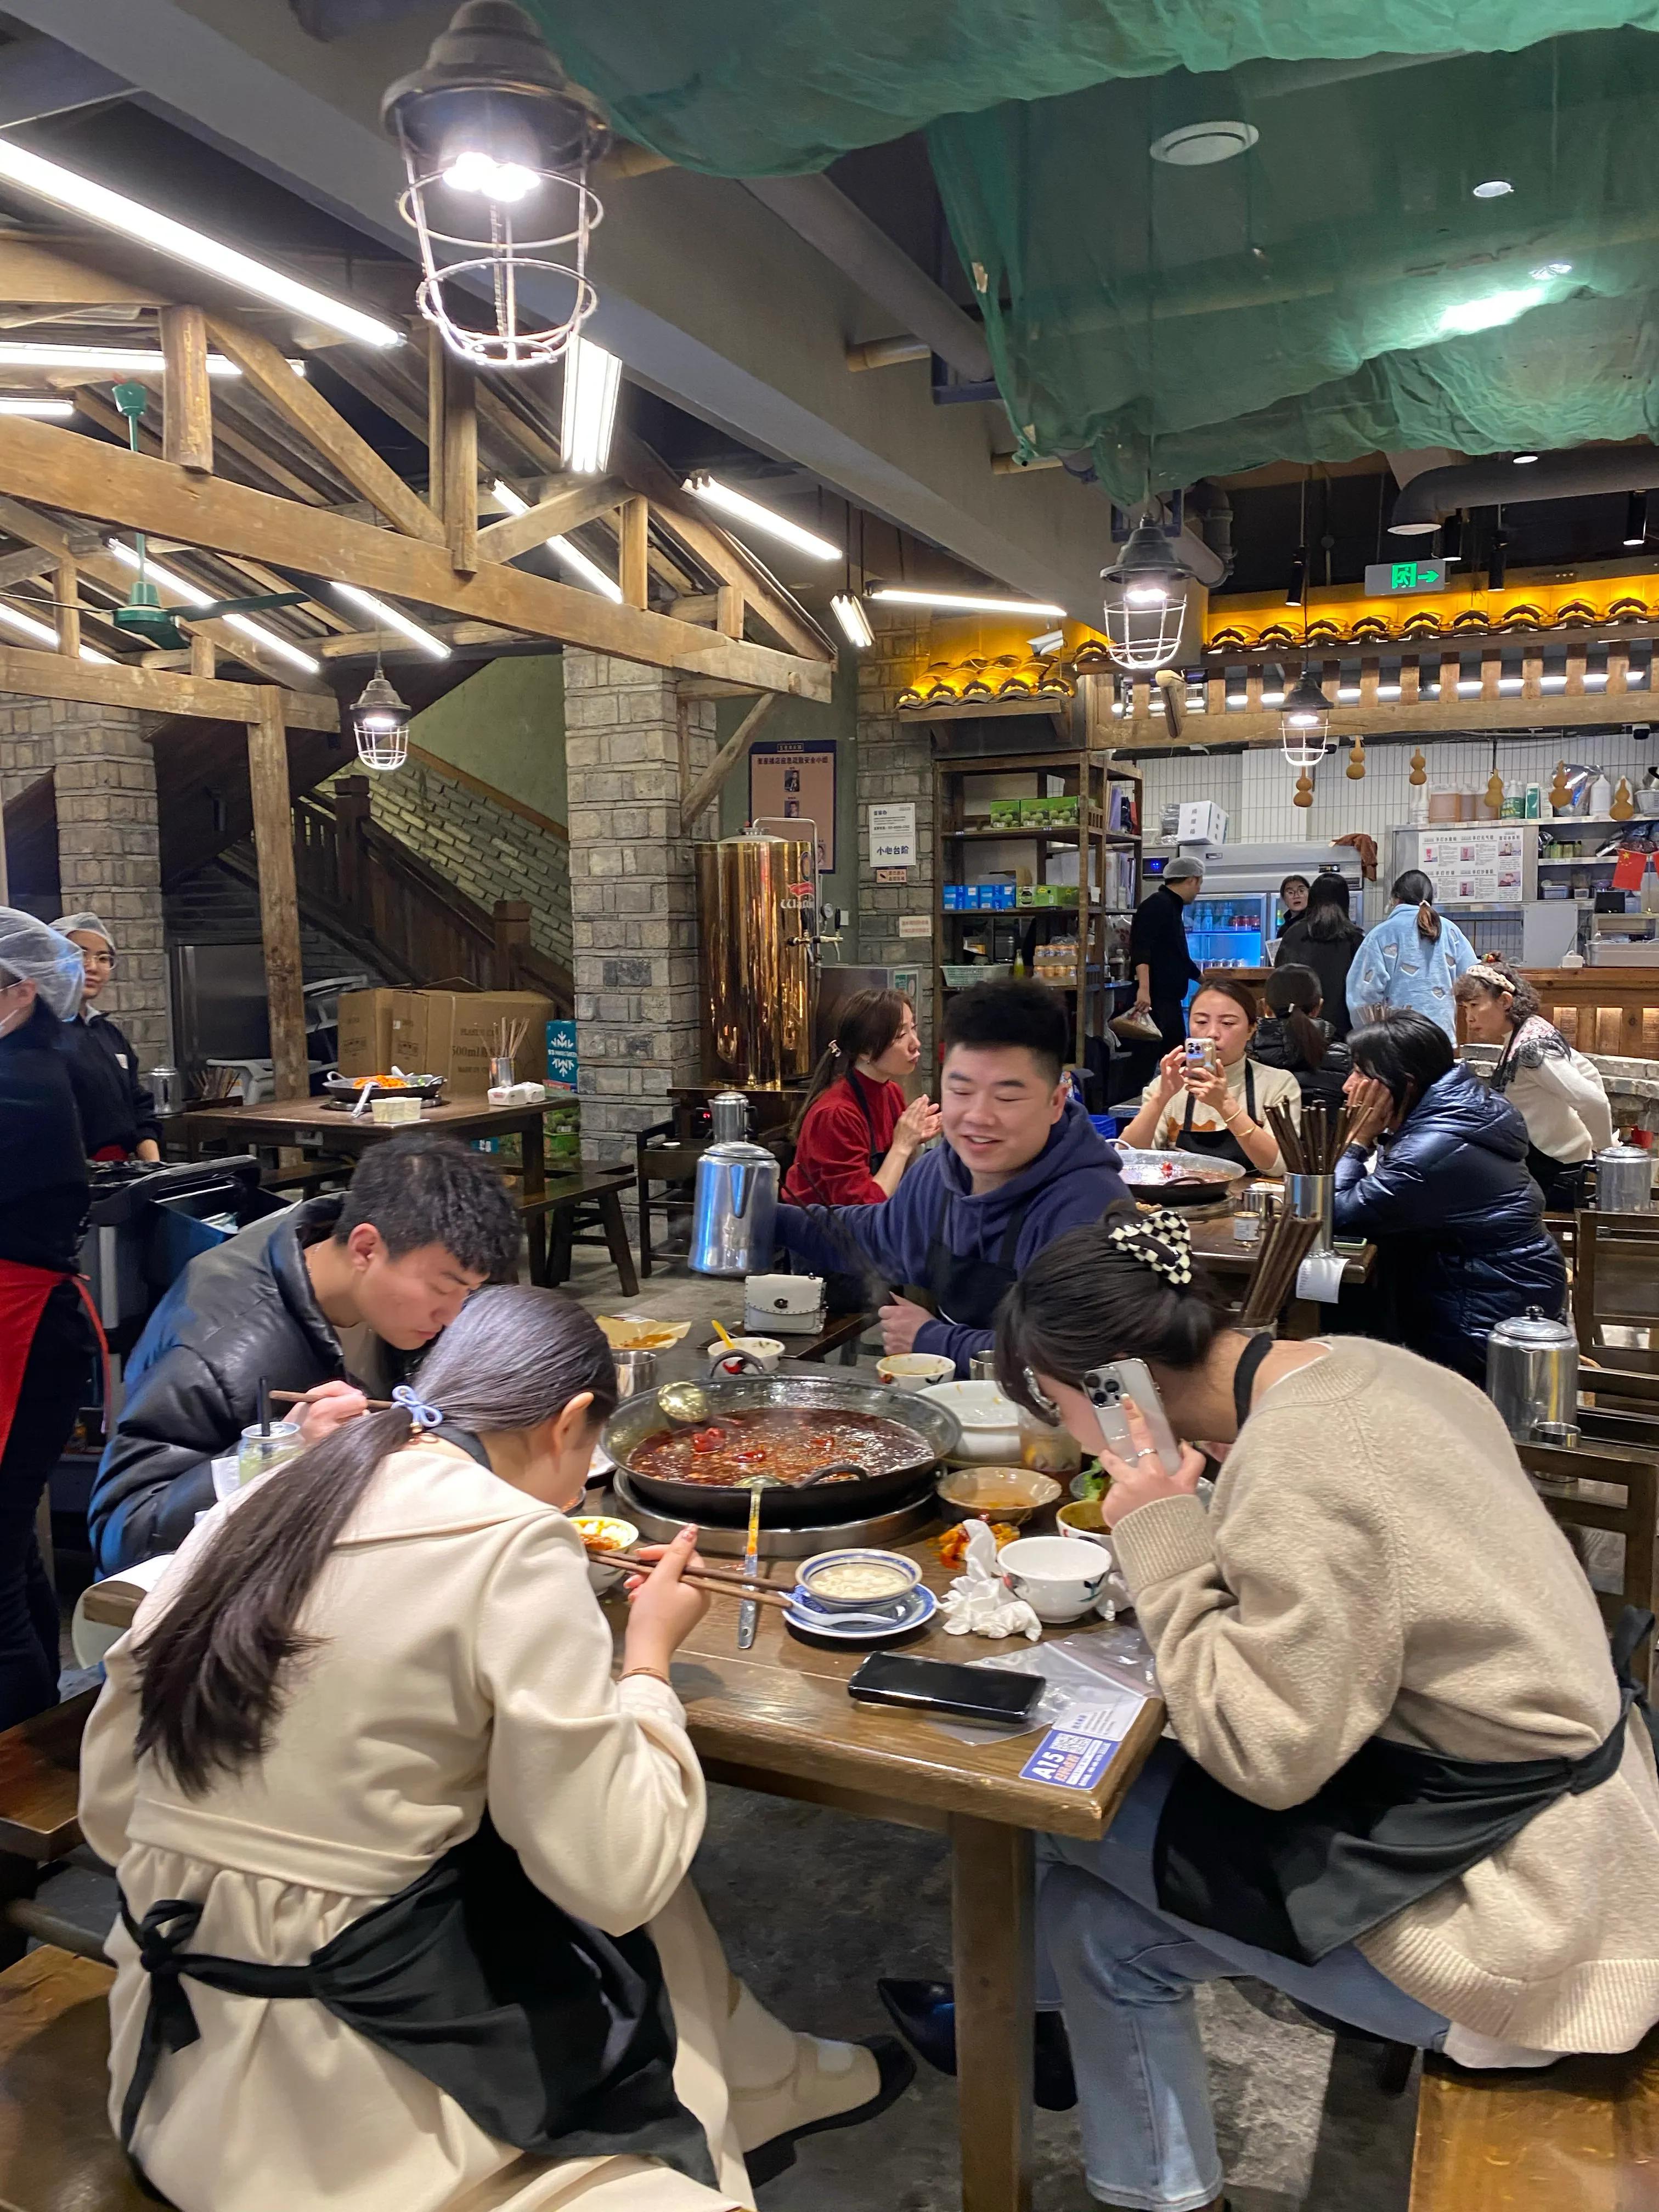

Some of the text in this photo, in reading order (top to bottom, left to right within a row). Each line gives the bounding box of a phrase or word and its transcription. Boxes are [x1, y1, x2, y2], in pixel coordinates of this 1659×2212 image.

[877, 845, 909, 855] 小心台阶
[1031, 1751, 1065, 1780] A15
